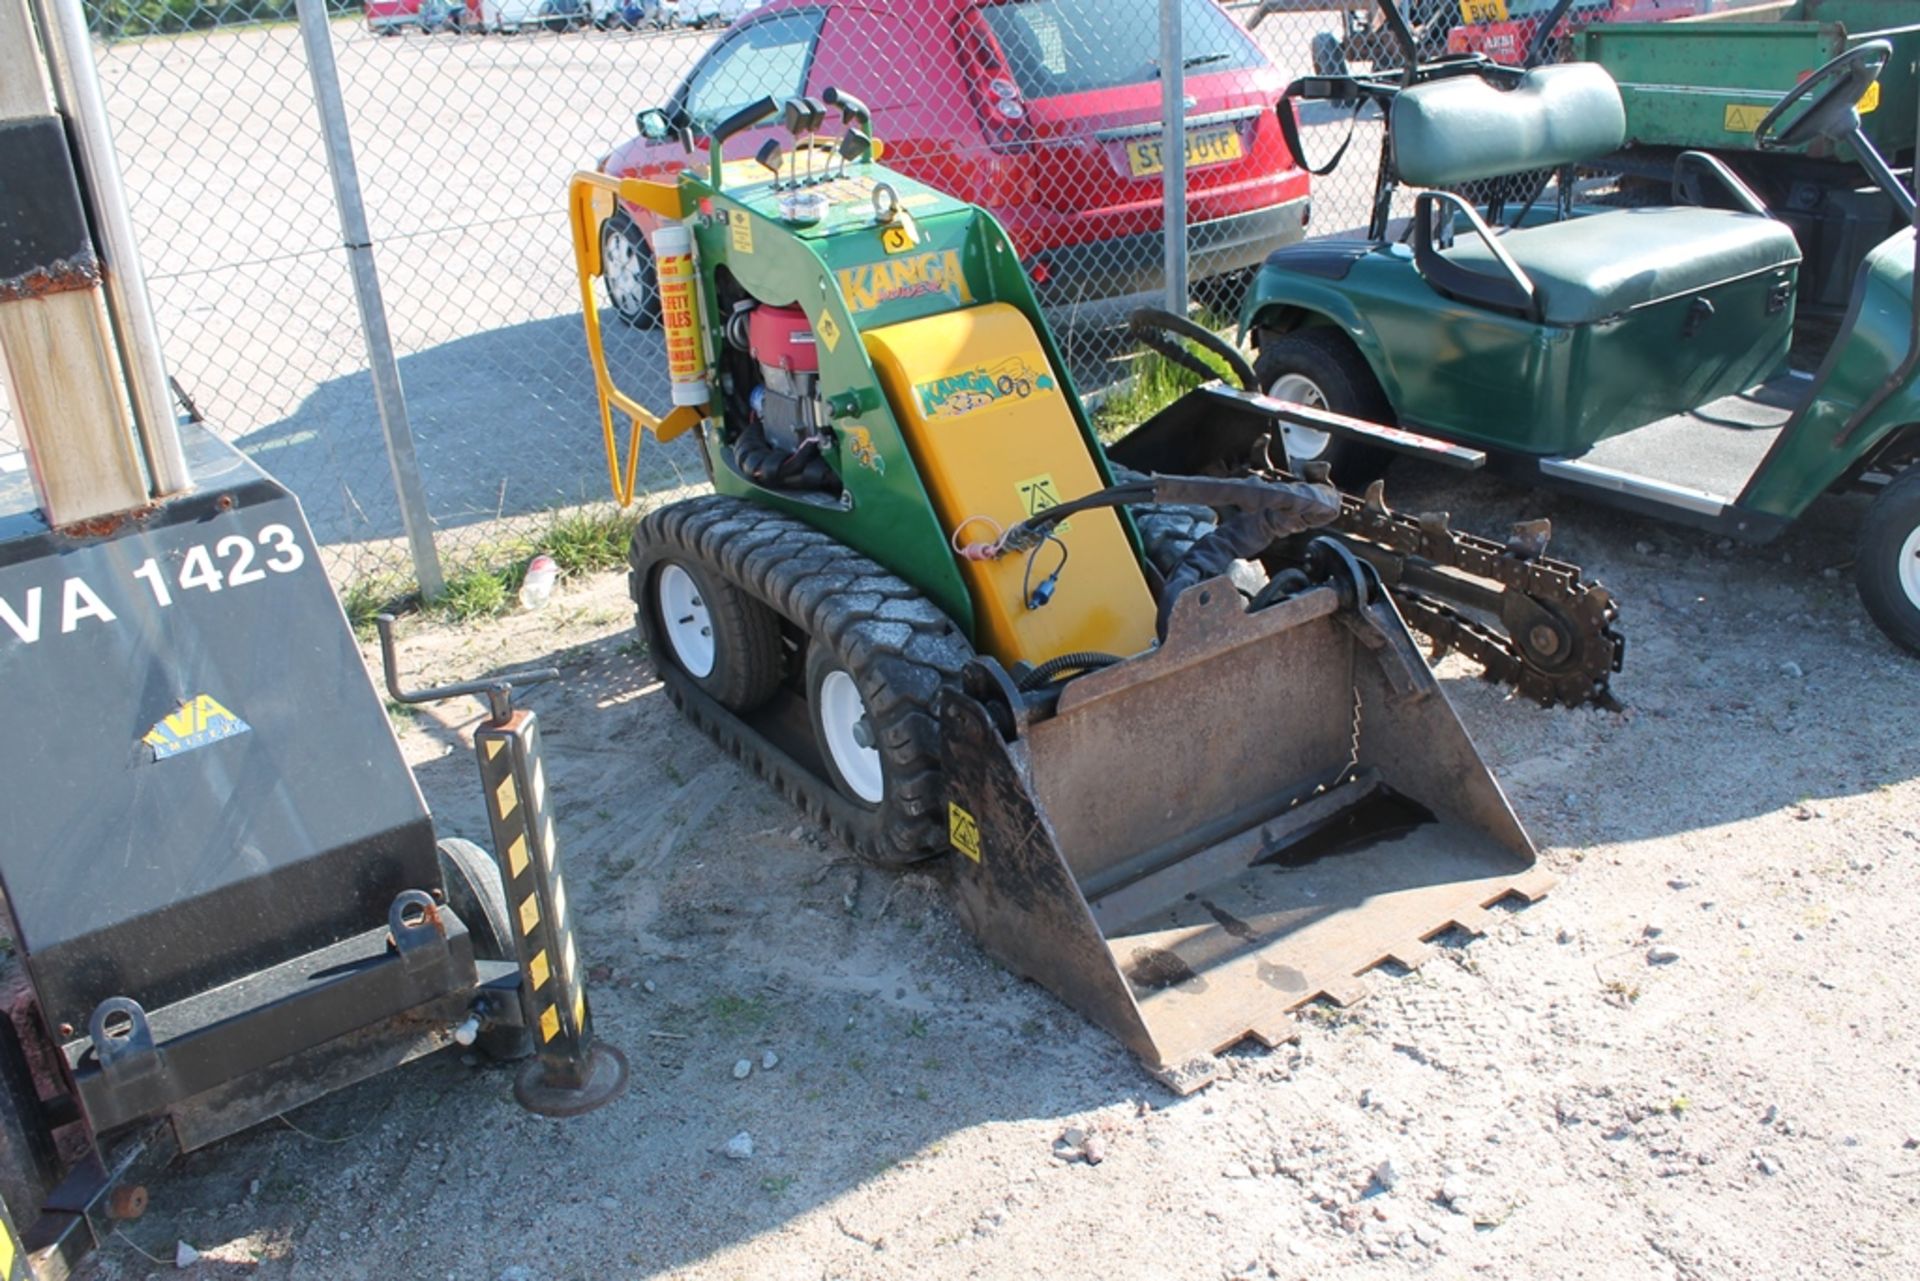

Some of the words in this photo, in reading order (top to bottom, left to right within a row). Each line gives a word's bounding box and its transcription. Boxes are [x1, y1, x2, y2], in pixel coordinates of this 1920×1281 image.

[837, 249, 976, 313] KANGA
[916, 370, 1003, 416] KANGA
[133, 523, 305, 608] 1423
